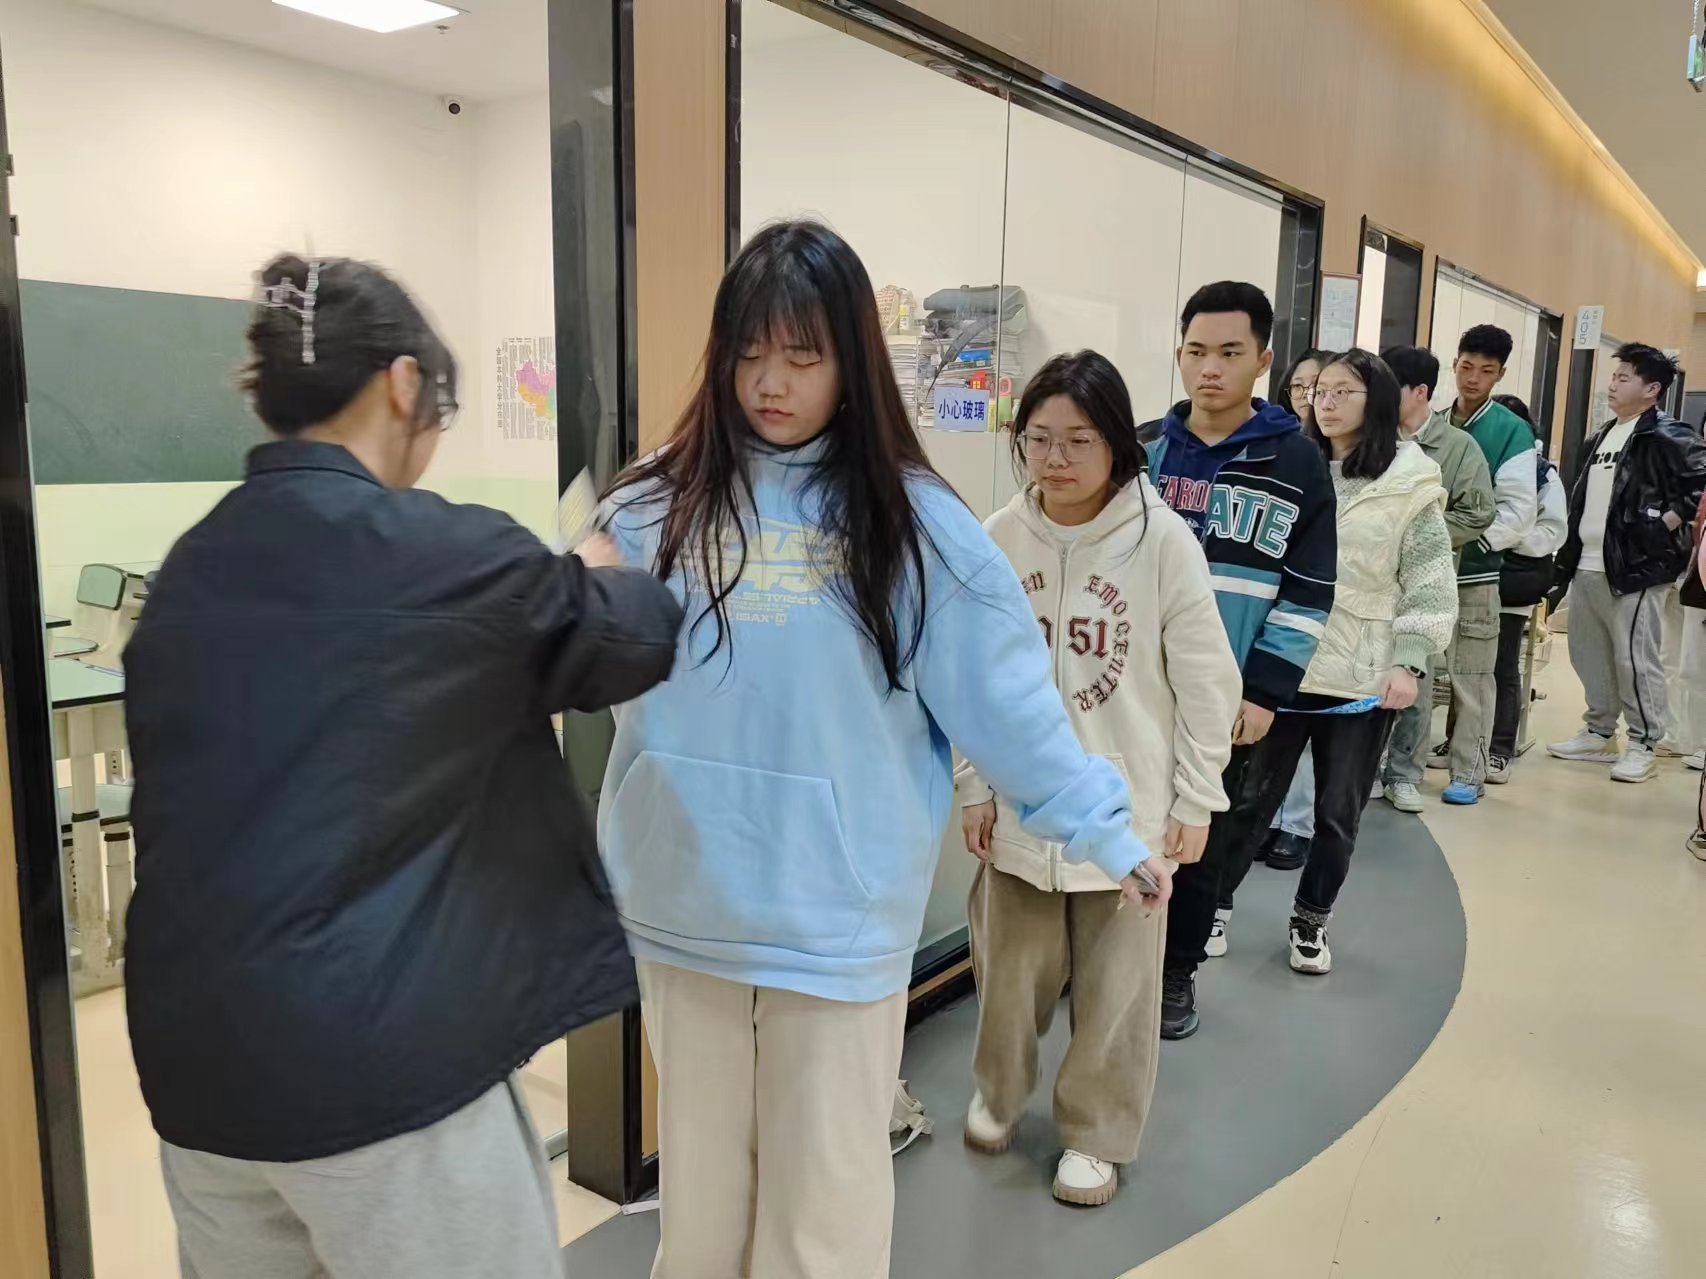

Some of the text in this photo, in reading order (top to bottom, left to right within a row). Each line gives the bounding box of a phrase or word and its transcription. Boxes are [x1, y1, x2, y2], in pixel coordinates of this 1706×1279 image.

[938, 398, 985, 421] 小心玻璃
[1067, 616, 1109, 660] 51
